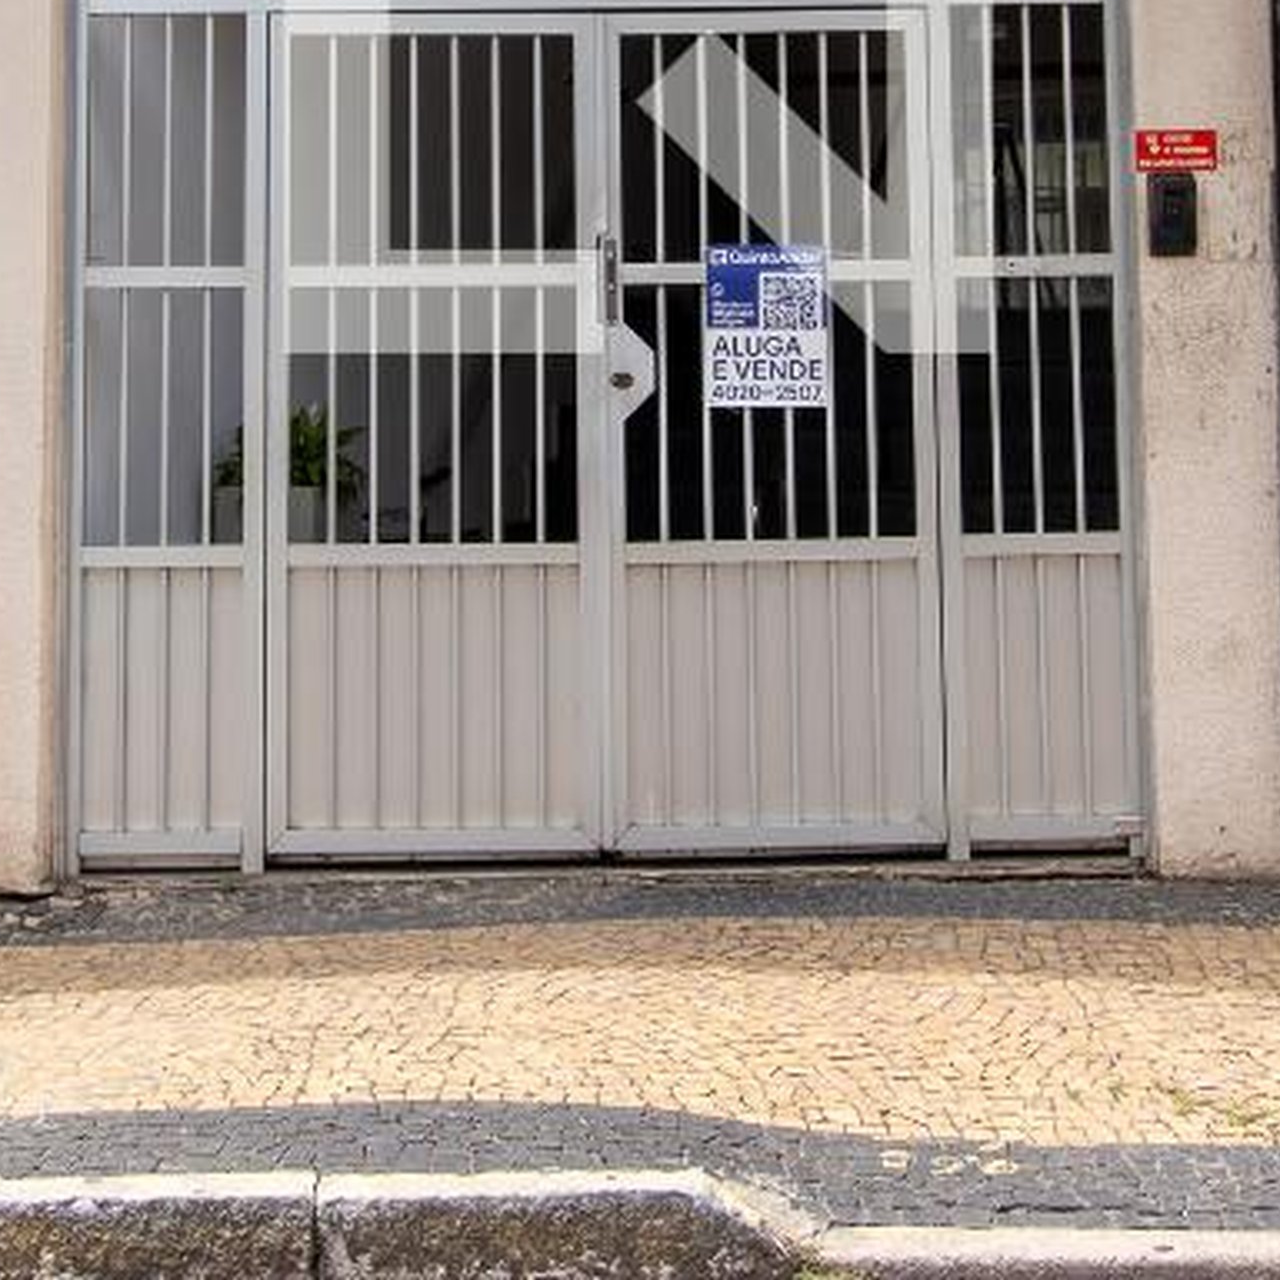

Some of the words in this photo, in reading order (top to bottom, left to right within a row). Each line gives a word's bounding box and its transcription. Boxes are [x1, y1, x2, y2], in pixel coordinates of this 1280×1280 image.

[712, 335, 803, 358] ALUGA
[713, 359, 728, 381] E
[733, 359, 823, 381] VENDE
